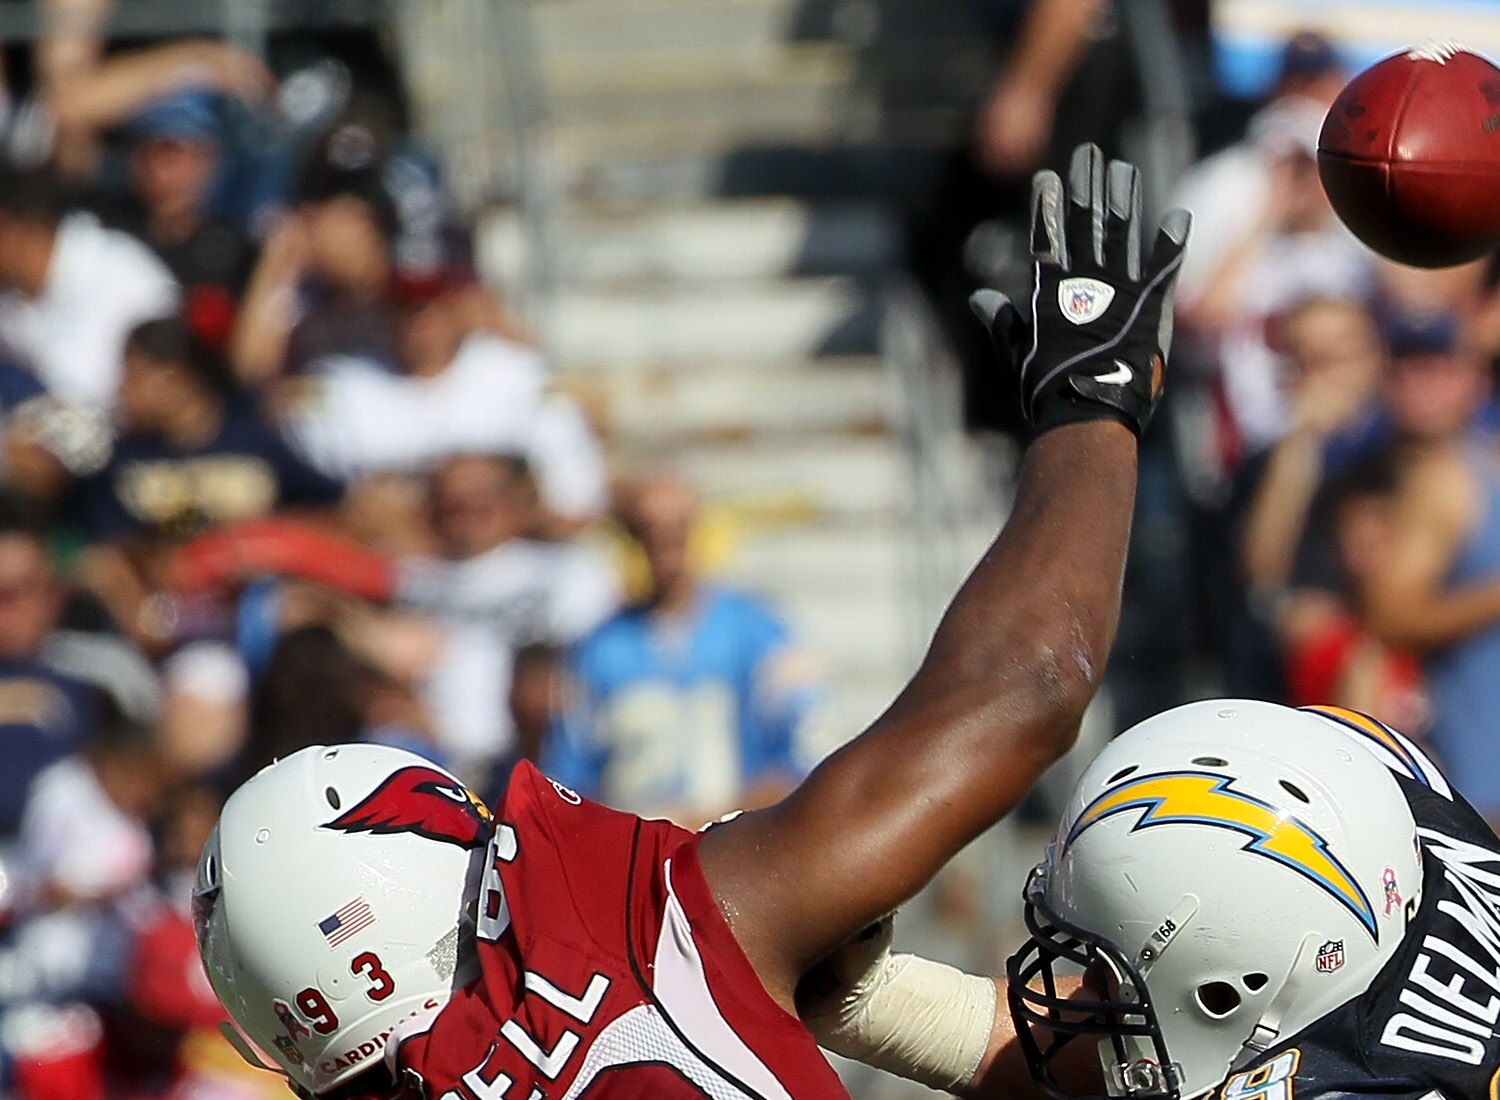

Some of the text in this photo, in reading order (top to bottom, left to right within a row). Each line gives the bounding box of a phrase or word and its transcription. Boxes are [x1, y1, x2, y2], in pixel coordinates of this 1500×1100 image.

[1158, 919, 1176, 938] 68
[1318, 952, 1343, 970] NFL
[295, 951, 395, 1035] 93
